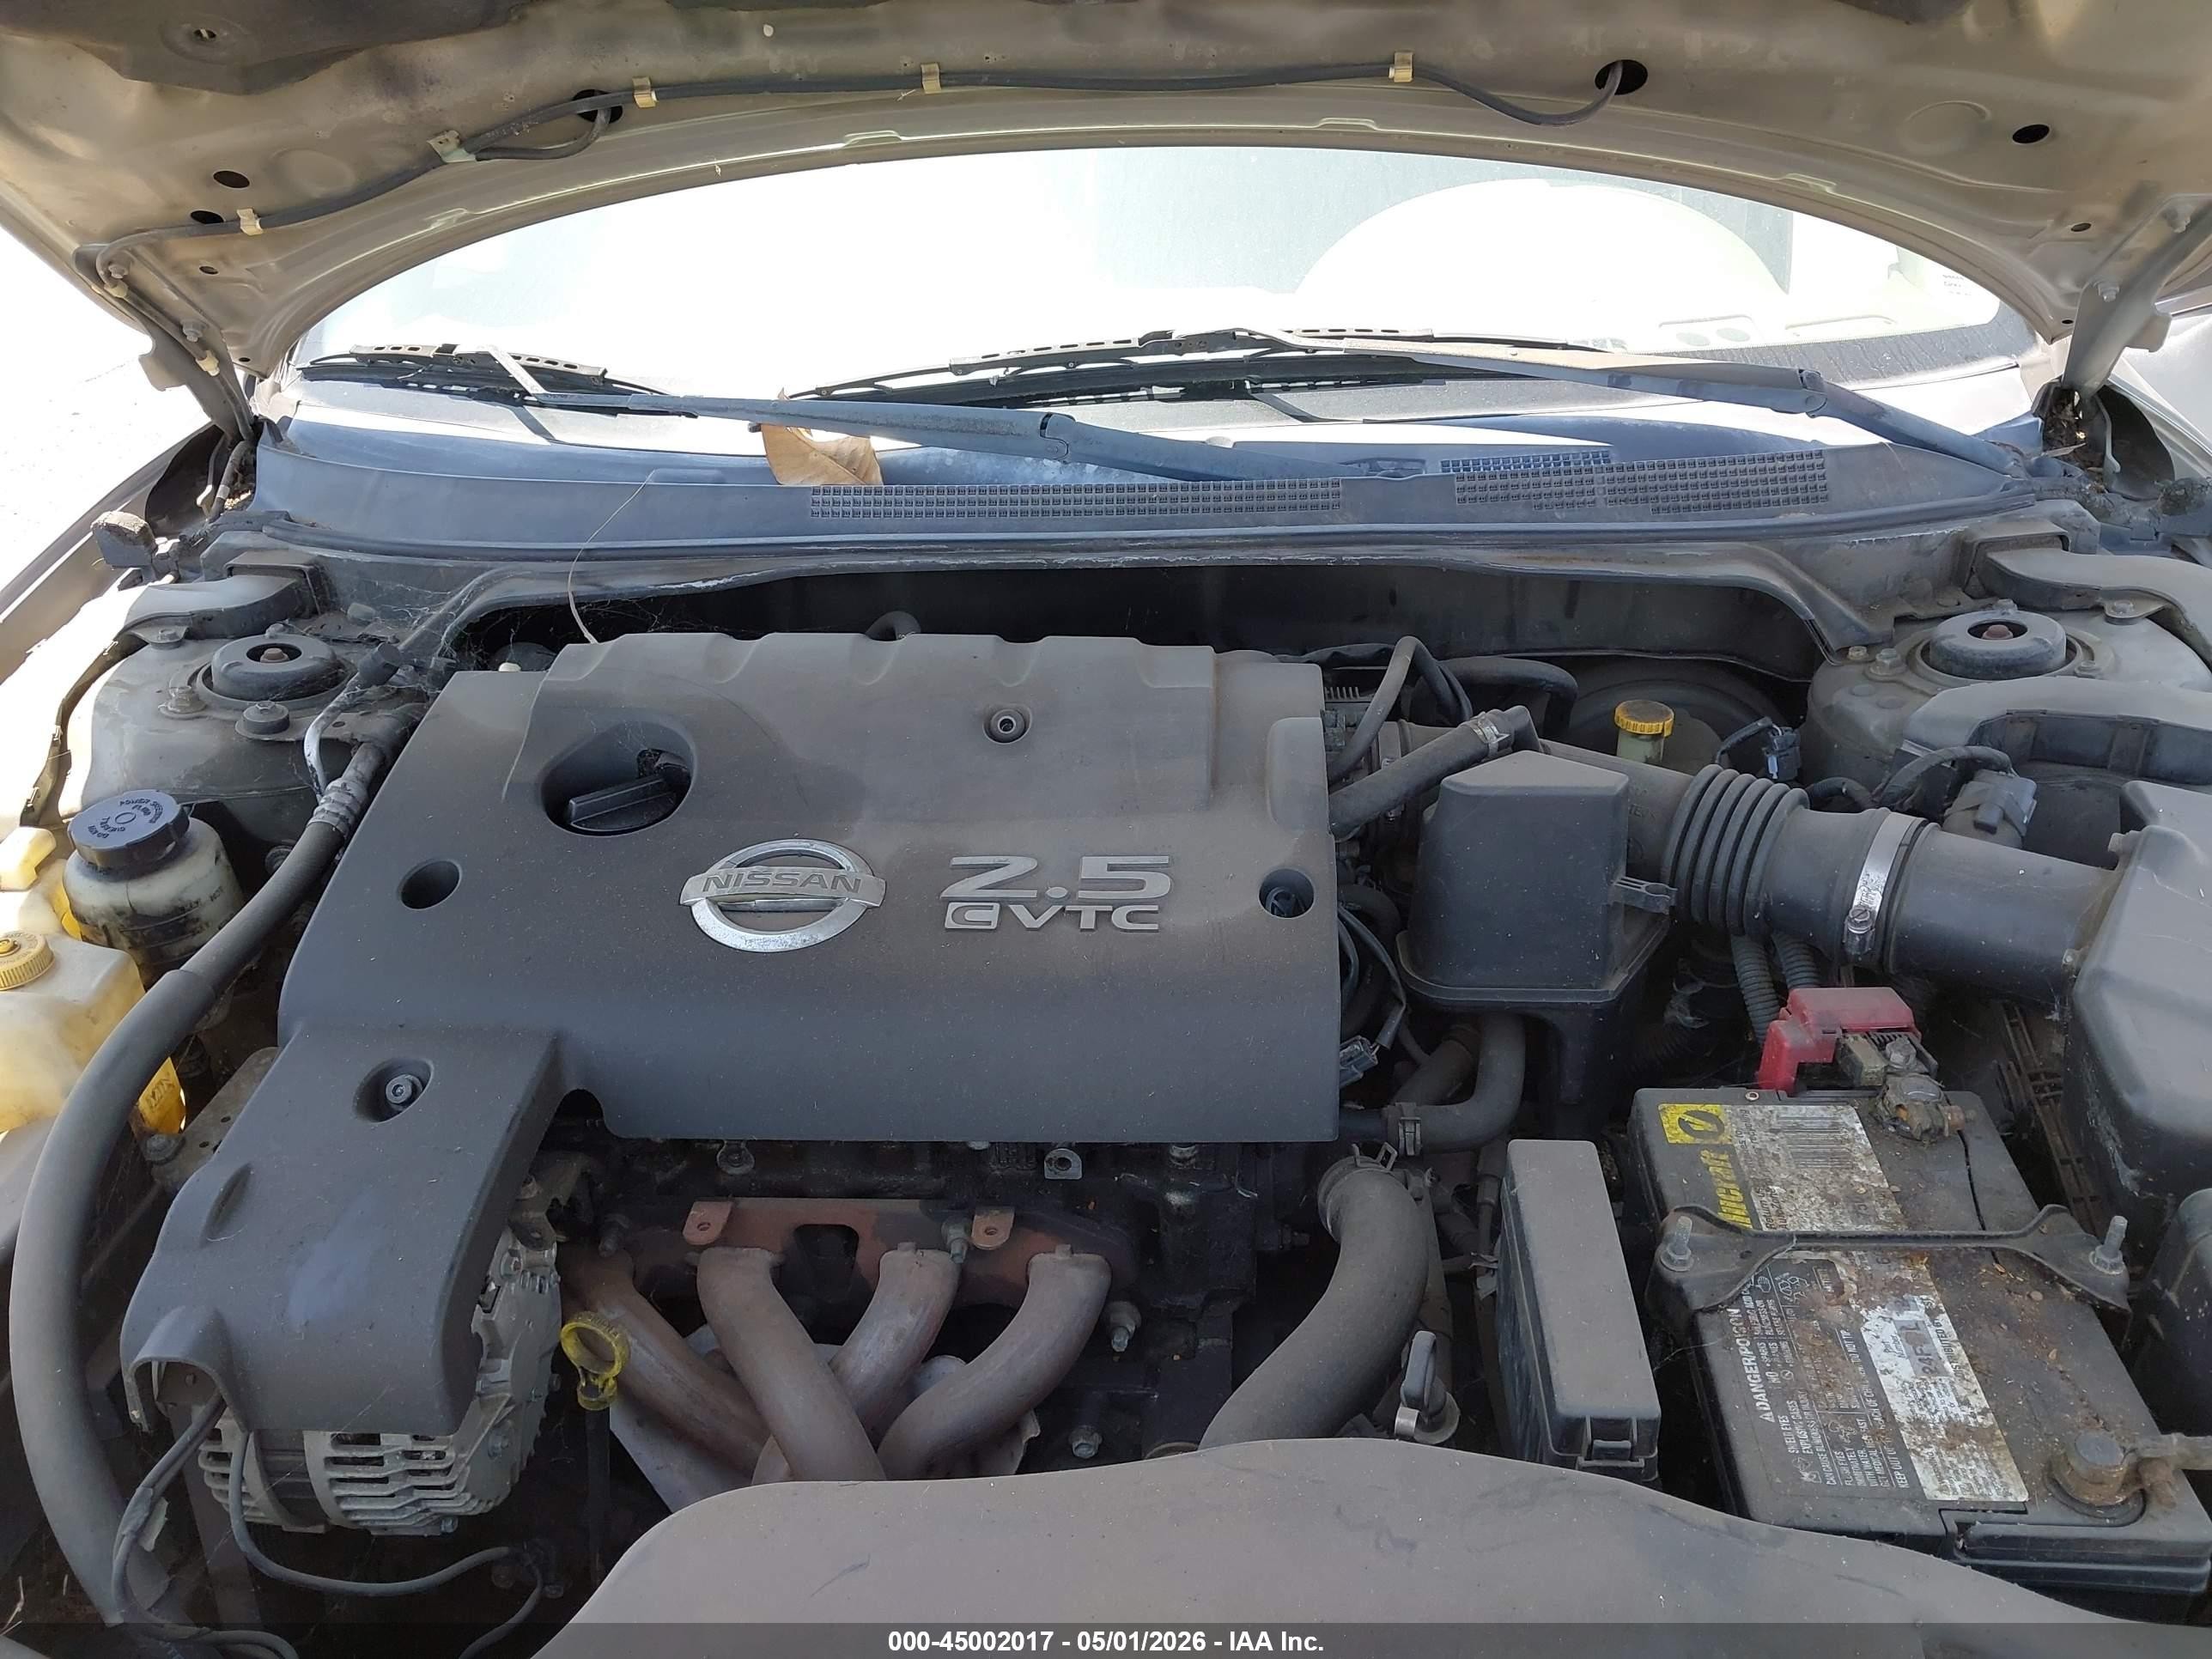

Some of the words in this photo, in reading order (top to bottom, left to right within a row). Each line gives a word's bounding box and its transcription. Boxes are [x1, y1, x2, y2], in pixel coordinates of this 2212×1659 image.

[701, 870, 863, 894] NISSAN
[940, 855, 1172, 900] 2.5
[1759, 1200, 1776, 1229] Return
[1743, 1296, 1754, 1308] ACID
[1845, 1340, 1857, 1352] NOT
[1881, 1340, 1893, 1352] Part
[1891, 1334, 1905, 1358] Number
[1728, 1307, 1771, 1410] DANGER/POISON
[1867, 1398, 1878, 1407] OF
[1778, 1415, 1791, 1430] EYES
[1818, 1453, 1832, 1471] CAUSE
[1889, 1455, 1903, 1469] OUT
[1825, 1473, 1837, 1484] CAN
[1867, 1471, 1880, 1486] WITH
[1894, 1471, 1910, 1487] KEEP
